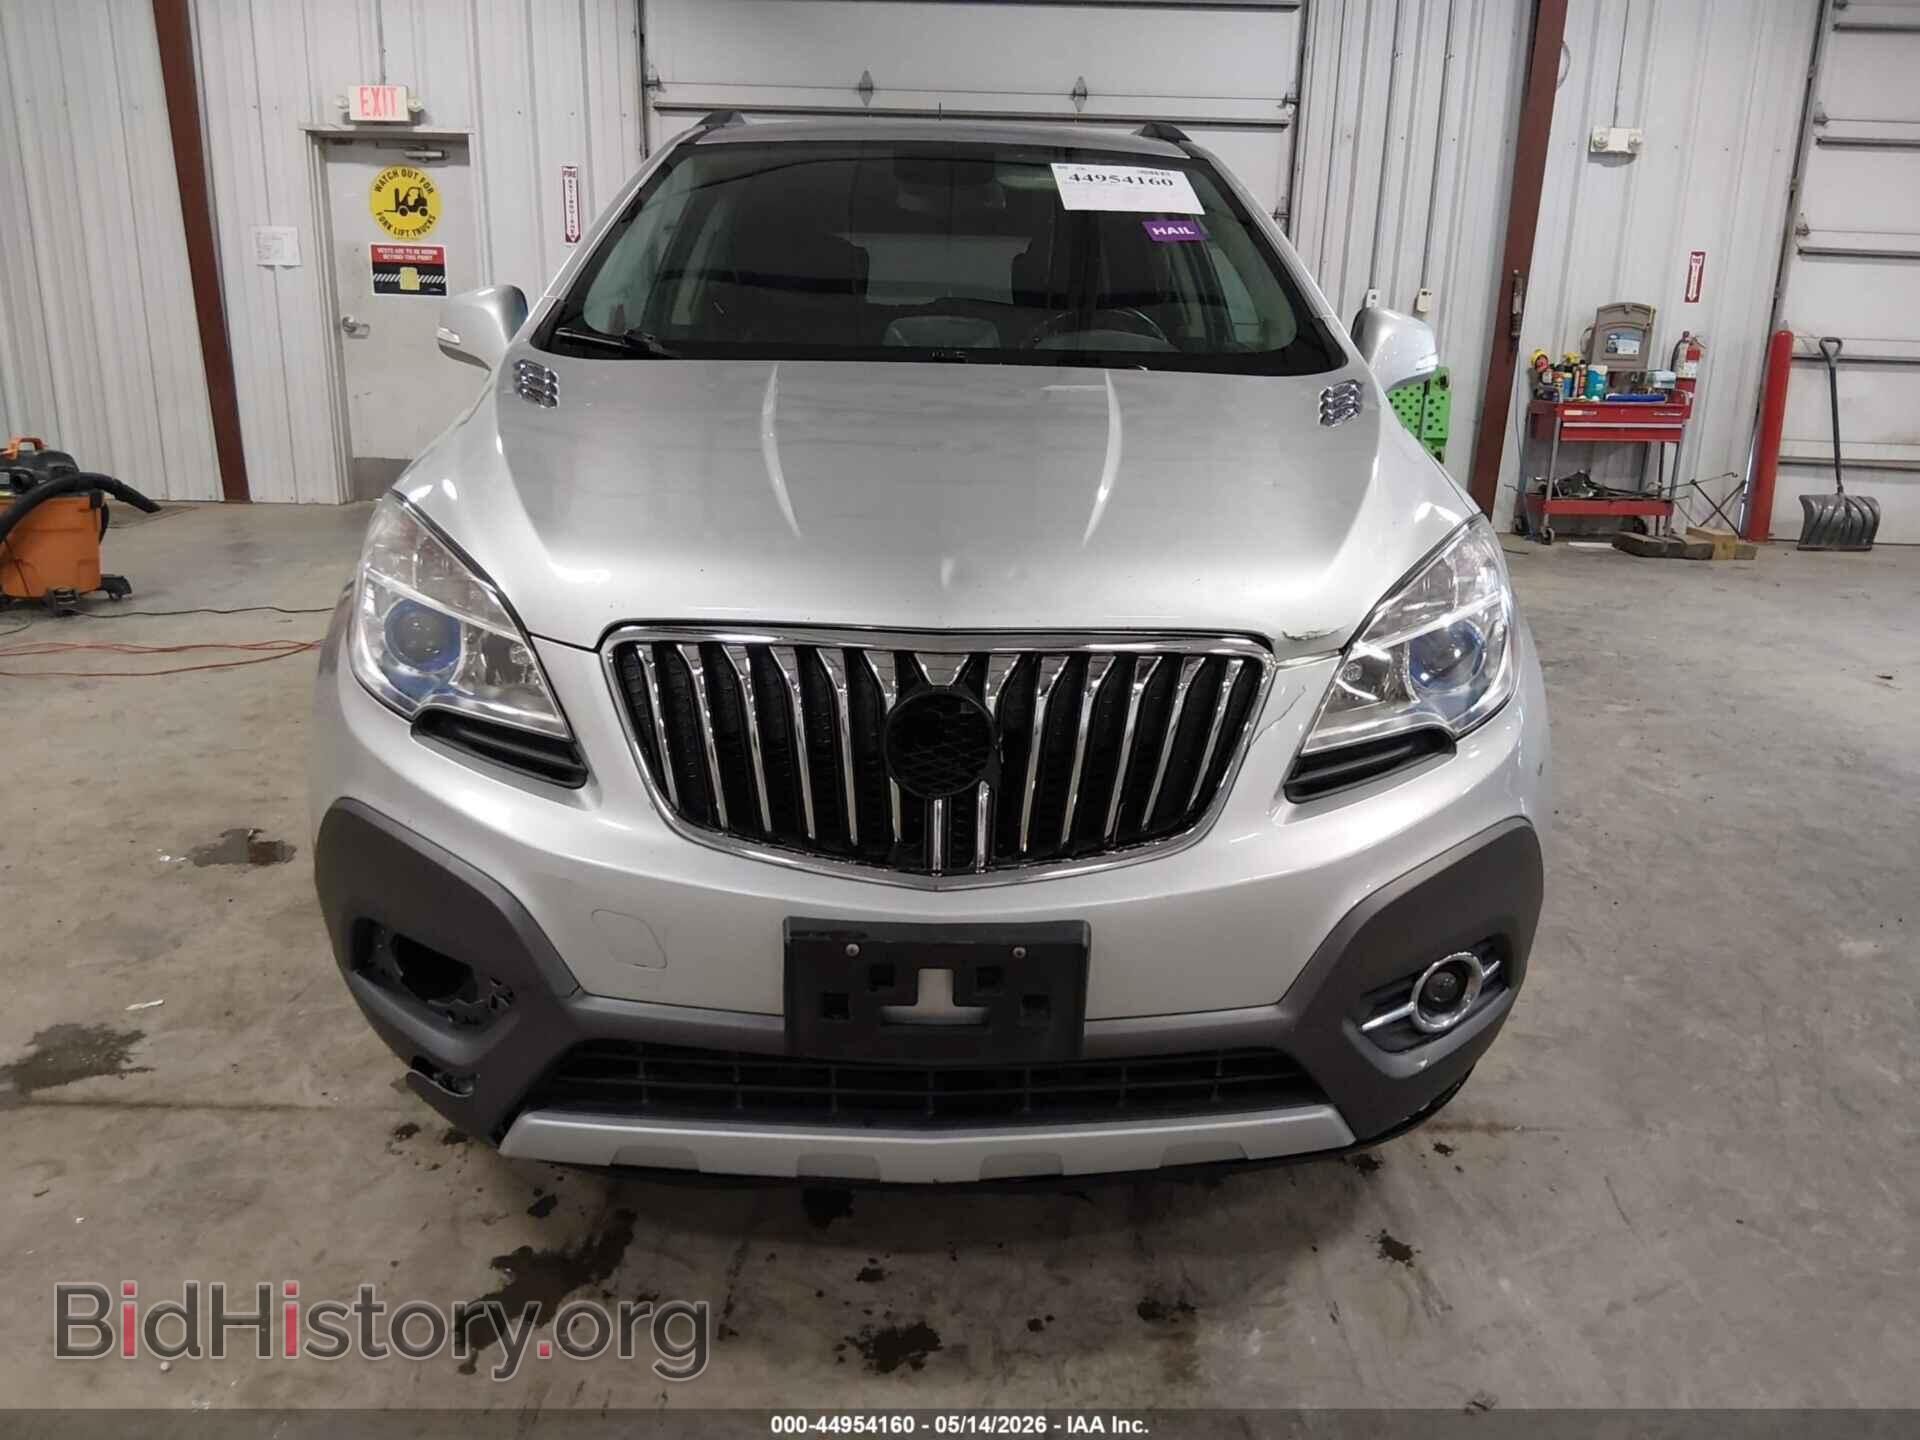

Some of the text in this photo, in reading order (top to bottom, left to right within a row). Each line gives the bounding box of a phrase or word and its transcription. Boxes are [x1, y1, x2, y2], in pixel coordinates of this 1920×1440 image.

[360, 86, 399, 117] EXIT
[374, 168, 434, 194] WATCH OUT FOR
[1069, 173, 1174, 186] 44954160
[375, 211, 437, 238] FORK LIFT TRUCKS
[1151, 225, 1196, 236] HAIL
